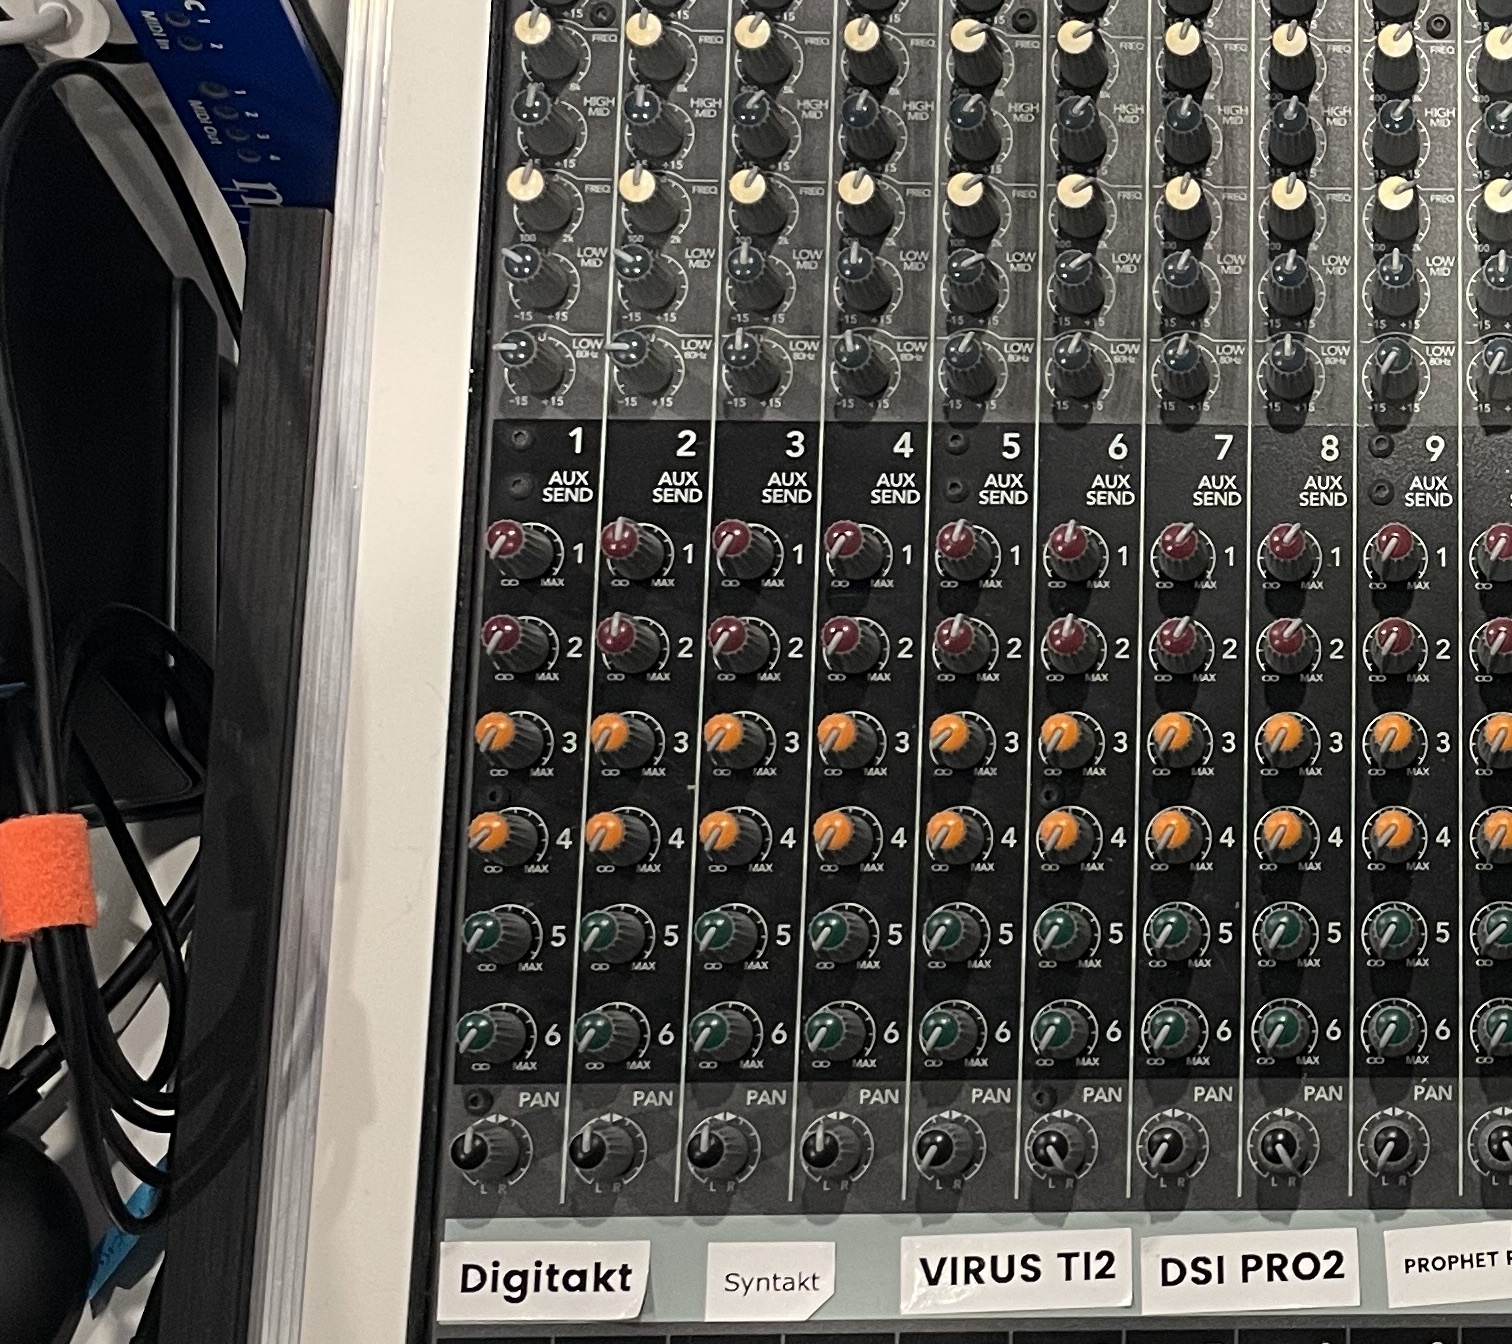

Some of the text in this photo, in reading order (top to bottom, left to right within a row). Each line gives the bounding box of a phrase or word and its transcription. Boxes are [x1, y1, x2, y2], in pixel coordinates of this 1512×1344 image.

[141, 10, 167, 37] MIDI
[188, 100, 222, 144] MIDI Out
[569, 427, 582, 453] 1
[893, 432, 914, 458] 4
[549, 471, 589, 485] AUX
[876, 473, 915, 487] AUX
[542, 487, 593, 502] SEND
[871, 489, 920, 504] SEND
[519, 1092, 559, 1107] PAN
[920, 1250, 1115, 1286] VIRUS TI2
[1162, 1250, 1344, 1286] DSI PRO2
[1405, 1251, 1498, 1273] PROPHET
[461, 1260, 632, 1303] Digitakt
[725, 1272, 819, 1296] Syntakt
